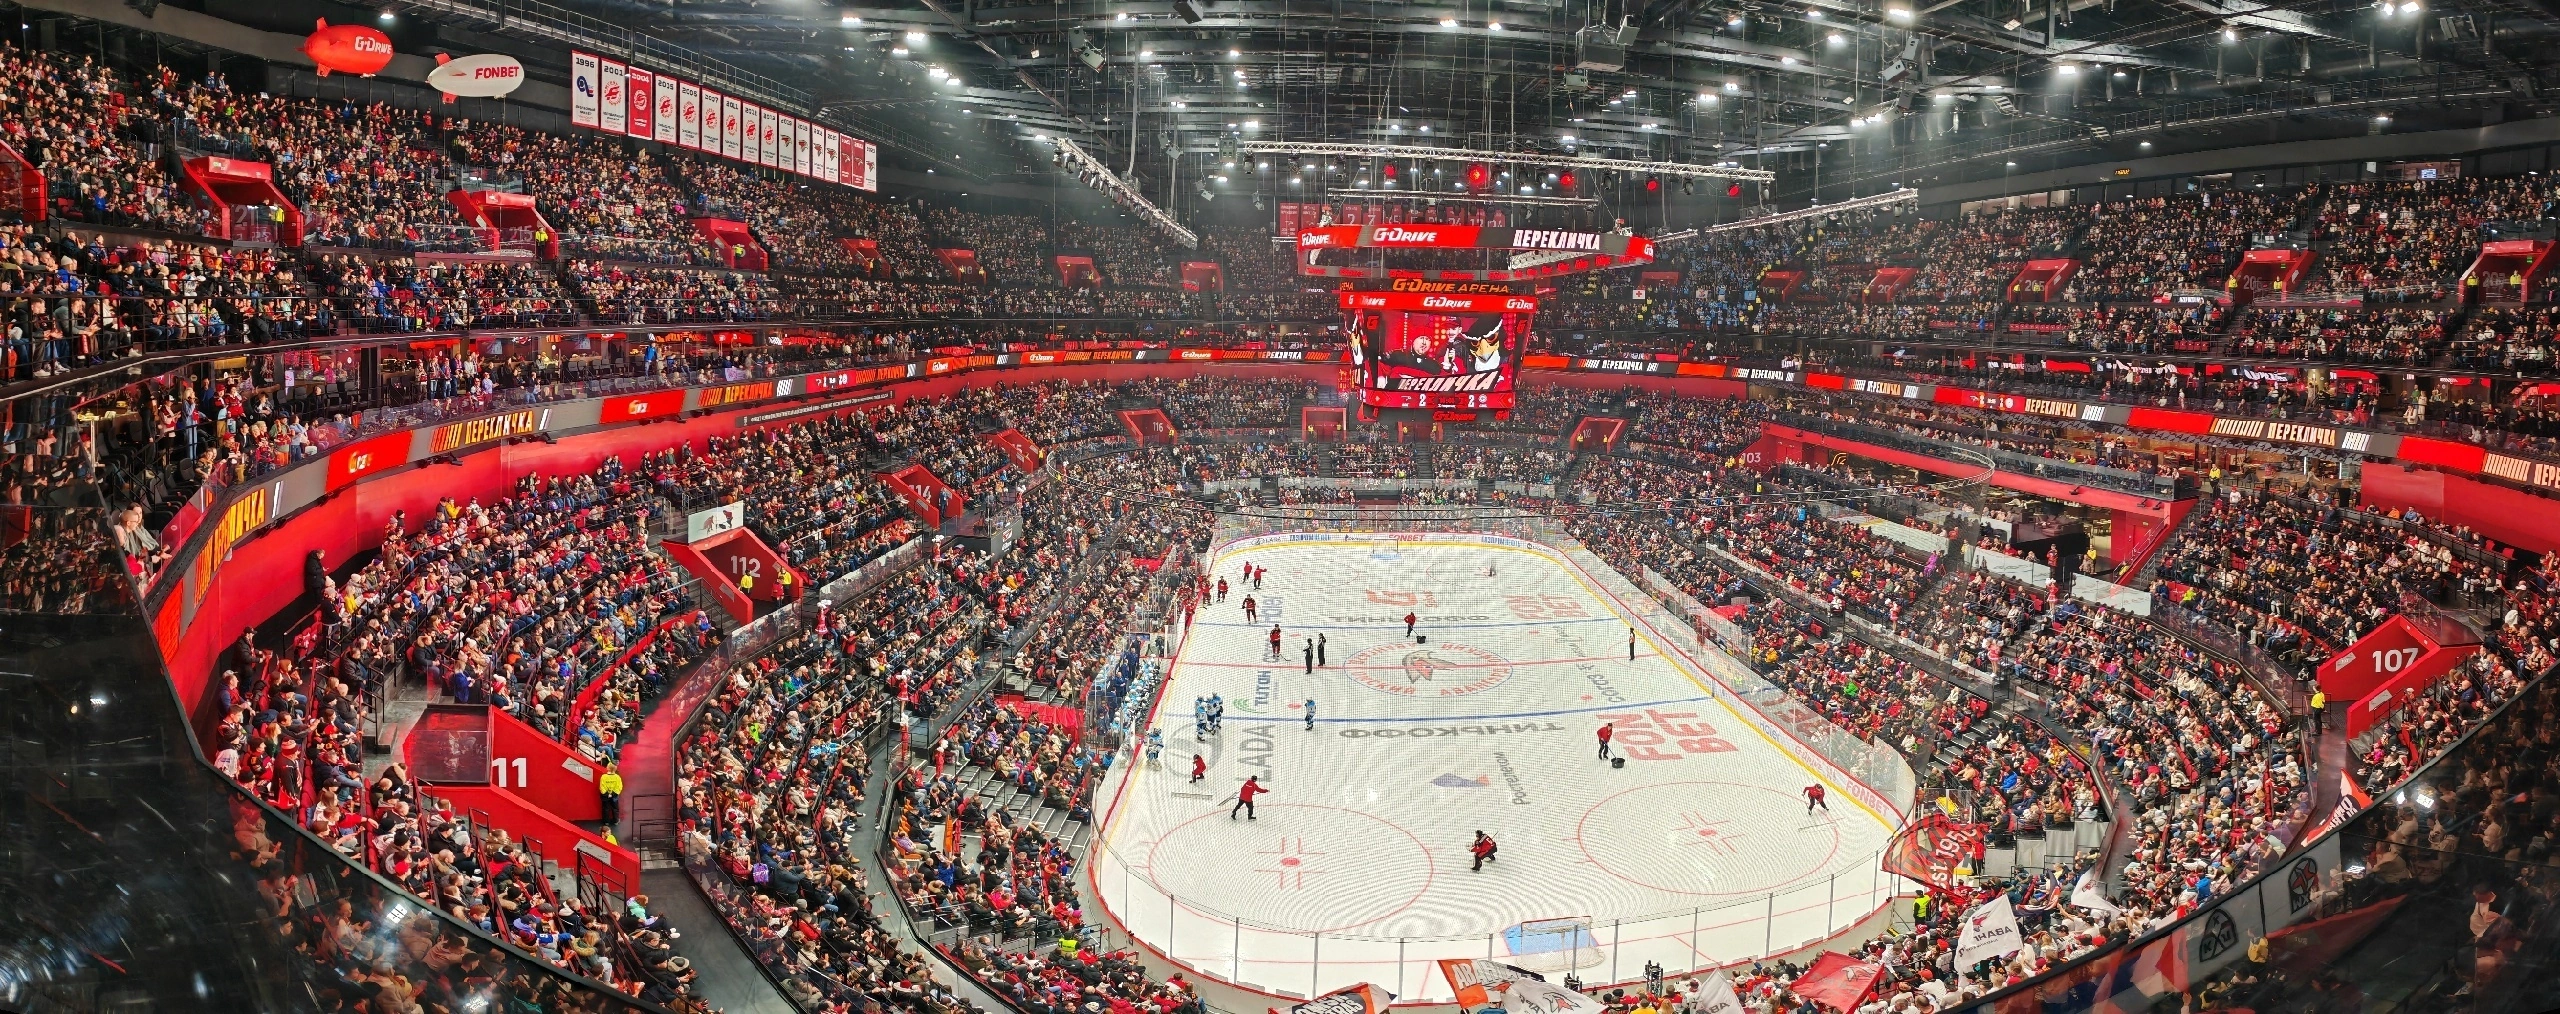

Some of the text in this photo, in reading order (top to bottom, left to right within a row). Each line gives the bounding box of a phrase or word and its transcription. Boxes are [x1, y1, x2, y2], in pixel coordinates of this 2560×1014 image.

[575, 57, 595, 68] 1996
[603, 65, 624, 76] 2001
[475, 66, 519, 80] FONBET
[1512, 230, 1600, 250] ПЕРЕКЛИЧКА
[1457, 283, 1509, 293] АРЕНА
[1397, 370, 1499, 392] ПЕРЕКЛИЧКА
[1418, 393, 1427, 407] 2
[1467, 394, 1475, 407] 2
[2024, 398, 2077, 418] ПЕРЕКЛИЧКА
[465, 411, 533, 444] ПЕРЕКЛИЧКА
[1152, 421, 1164, 433] 116
[2266, 422, 2336, 446] ПЕРЕКЛИЧКА
[1741, 452, 1761, 464] 103
[730, 555, 761, 578] 112
[2372, 648, 2419, 673] 107
[1338, 721, 1566, 739] ТИНЬКОФФ
[1596, 709, 1739, 761] FON BET
[1235, 724, 1276, 783] LADA
[1845, 779, 1890, 817] FONBET
